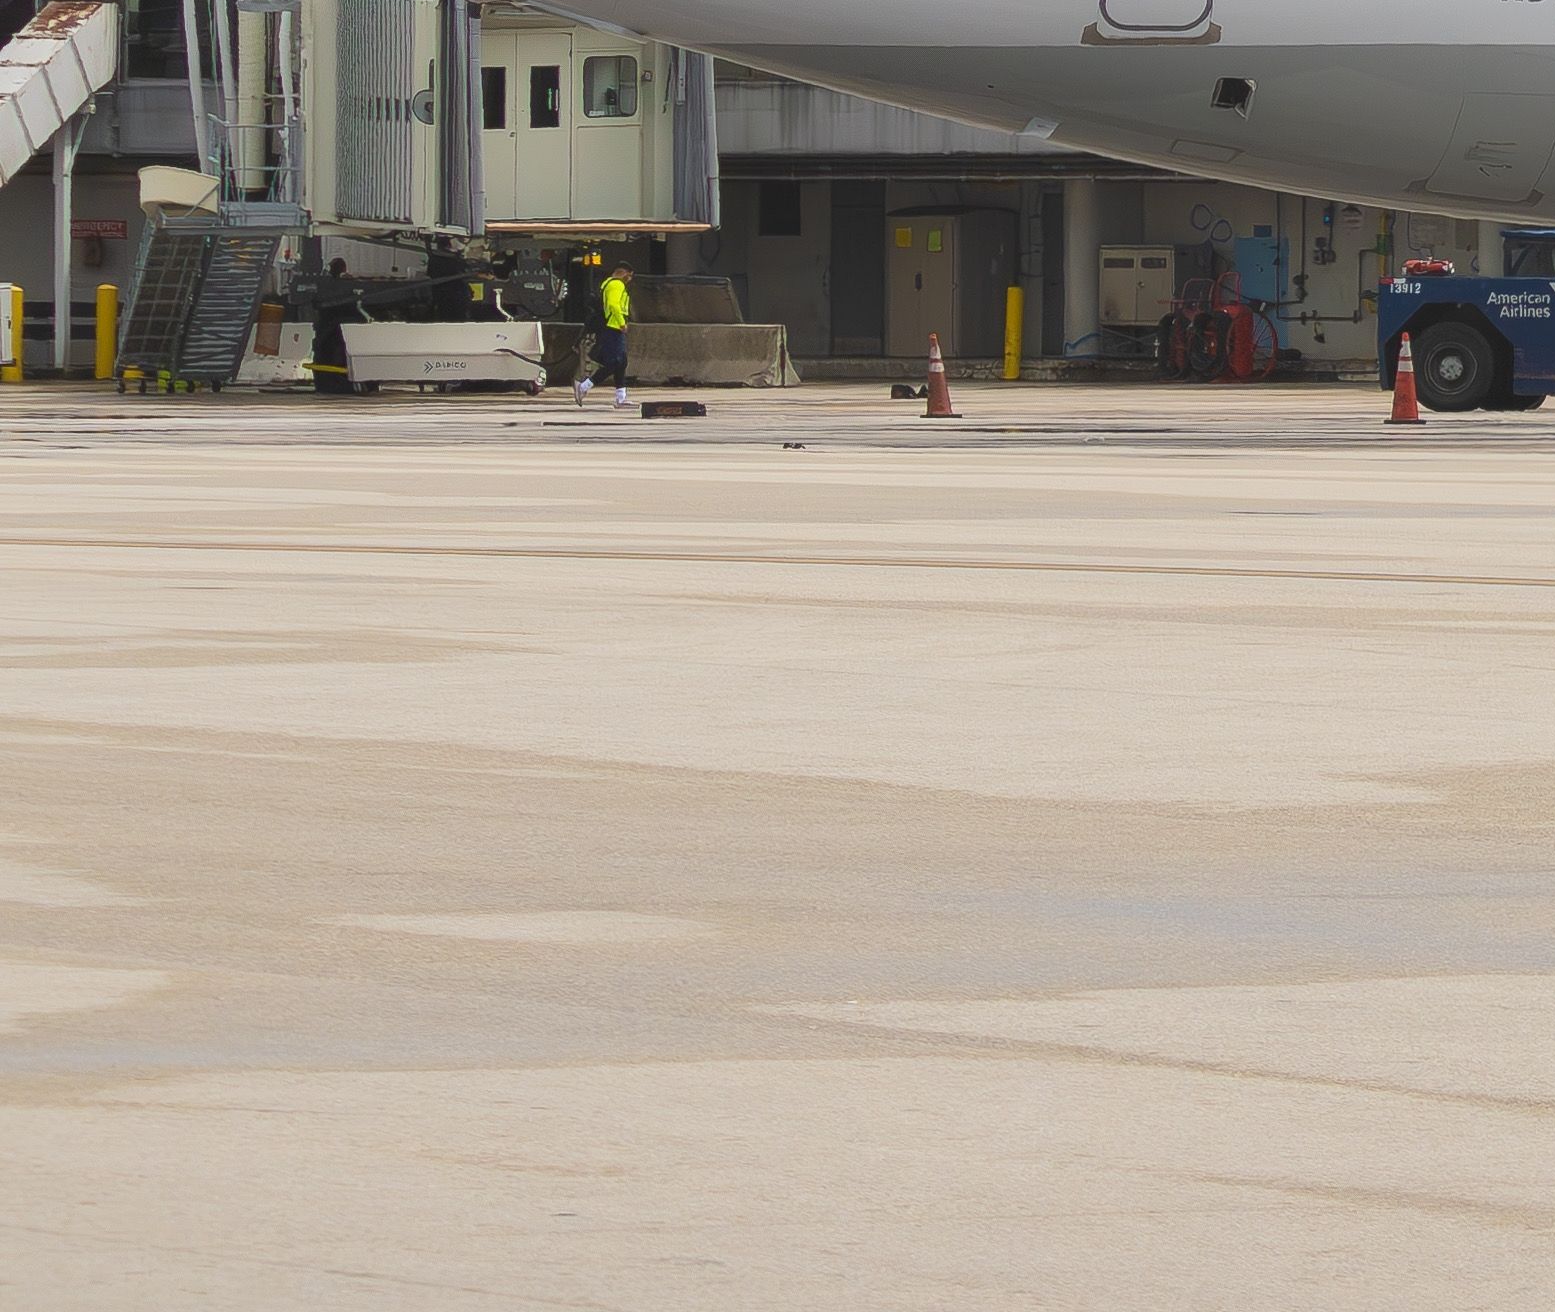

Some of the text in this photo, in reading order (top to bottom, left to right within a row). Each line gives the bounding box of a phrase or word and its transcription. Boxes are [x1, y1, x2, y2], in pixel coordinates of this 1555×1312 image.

[1389, 282, 1422, 294] 13912
[1486, 291, 1551, 305] American
[1499, 305, 1551, 318] Airlines
